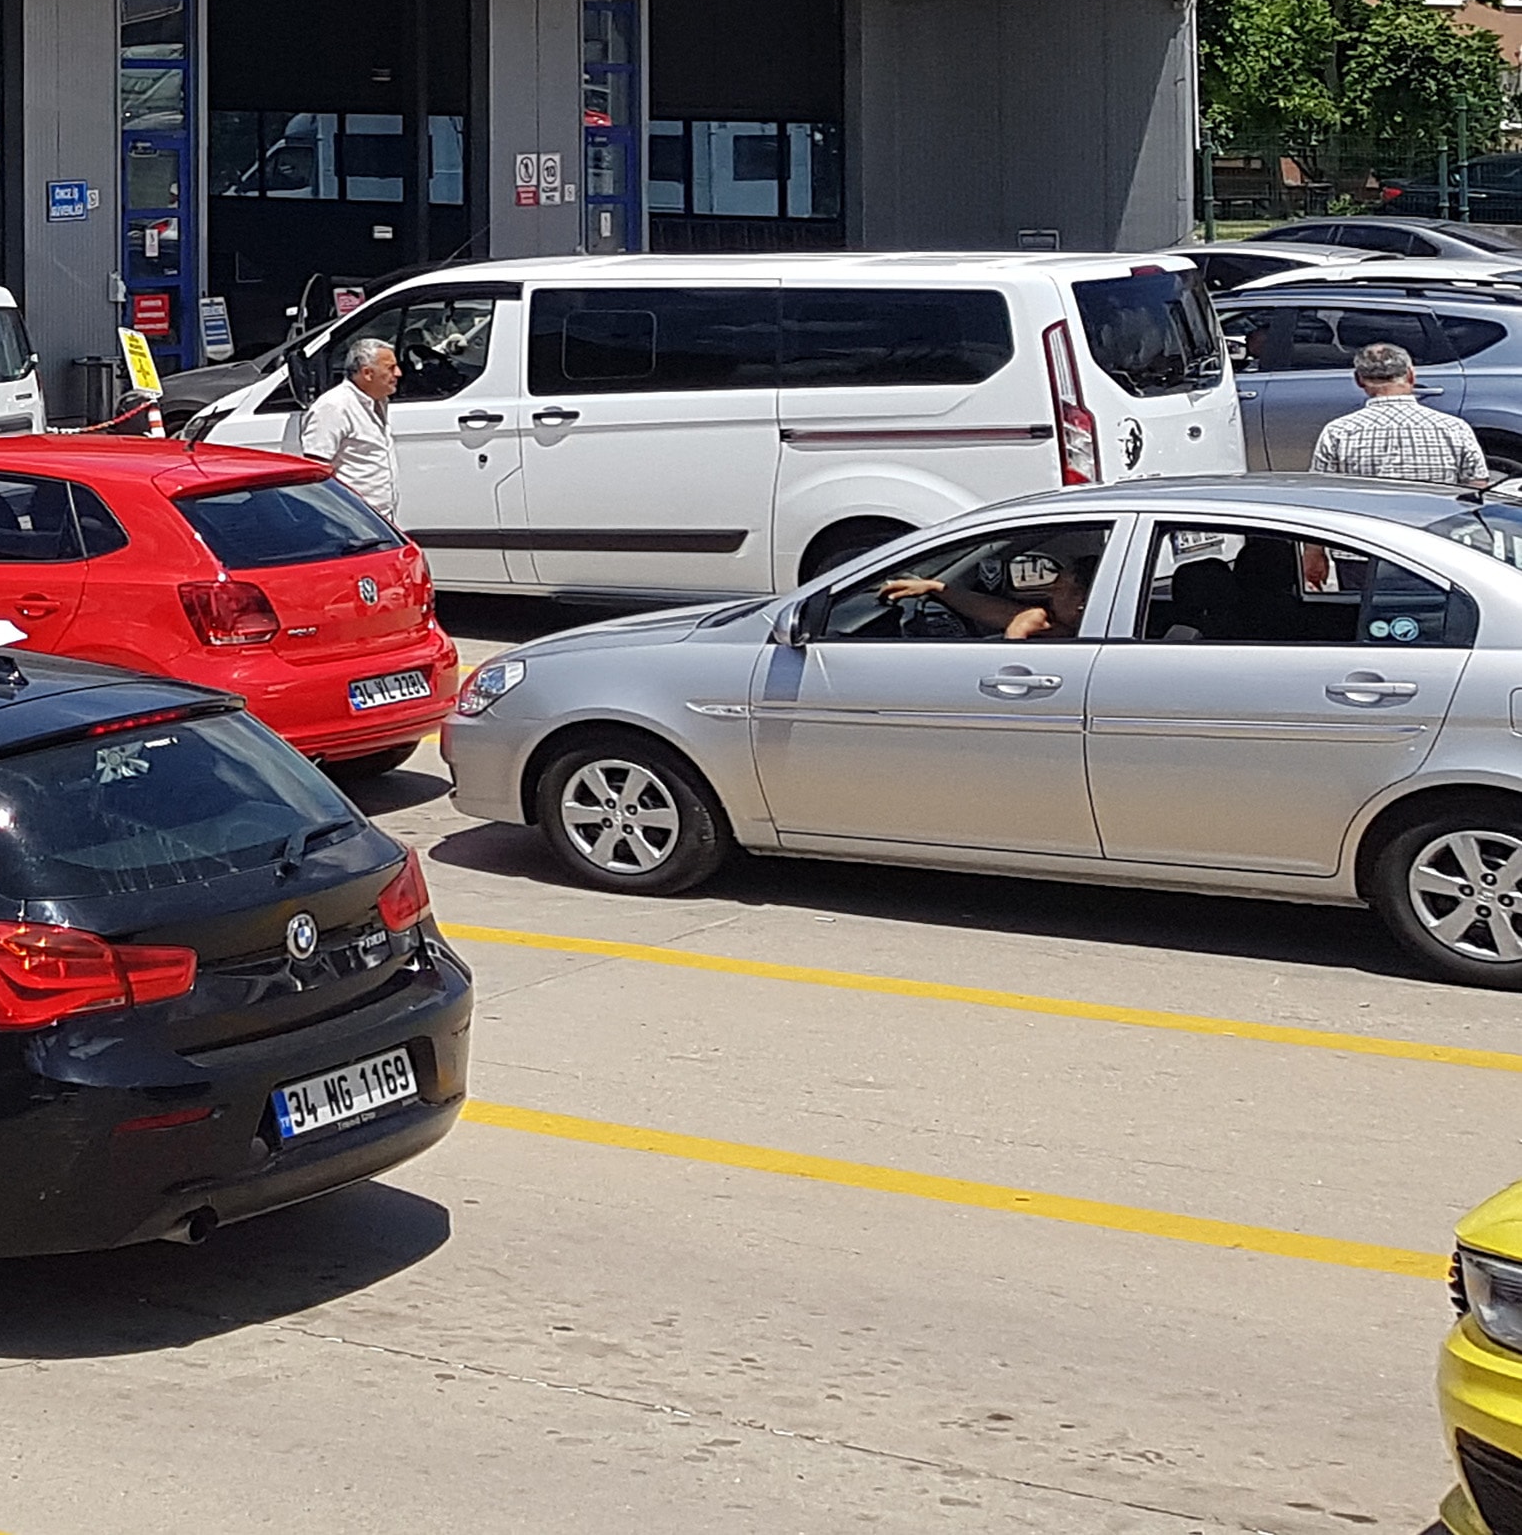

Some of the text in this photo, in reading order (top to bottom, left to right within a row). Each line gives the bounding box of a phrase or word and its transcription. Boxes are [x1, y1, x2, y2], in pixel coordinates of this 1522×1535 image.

[354, 682, 376, 706] 34
[288, 1087, 319, 1128] 34
[323, 1073, 355, 1117] NG
[359, 1055, 411, 1104] 1169
